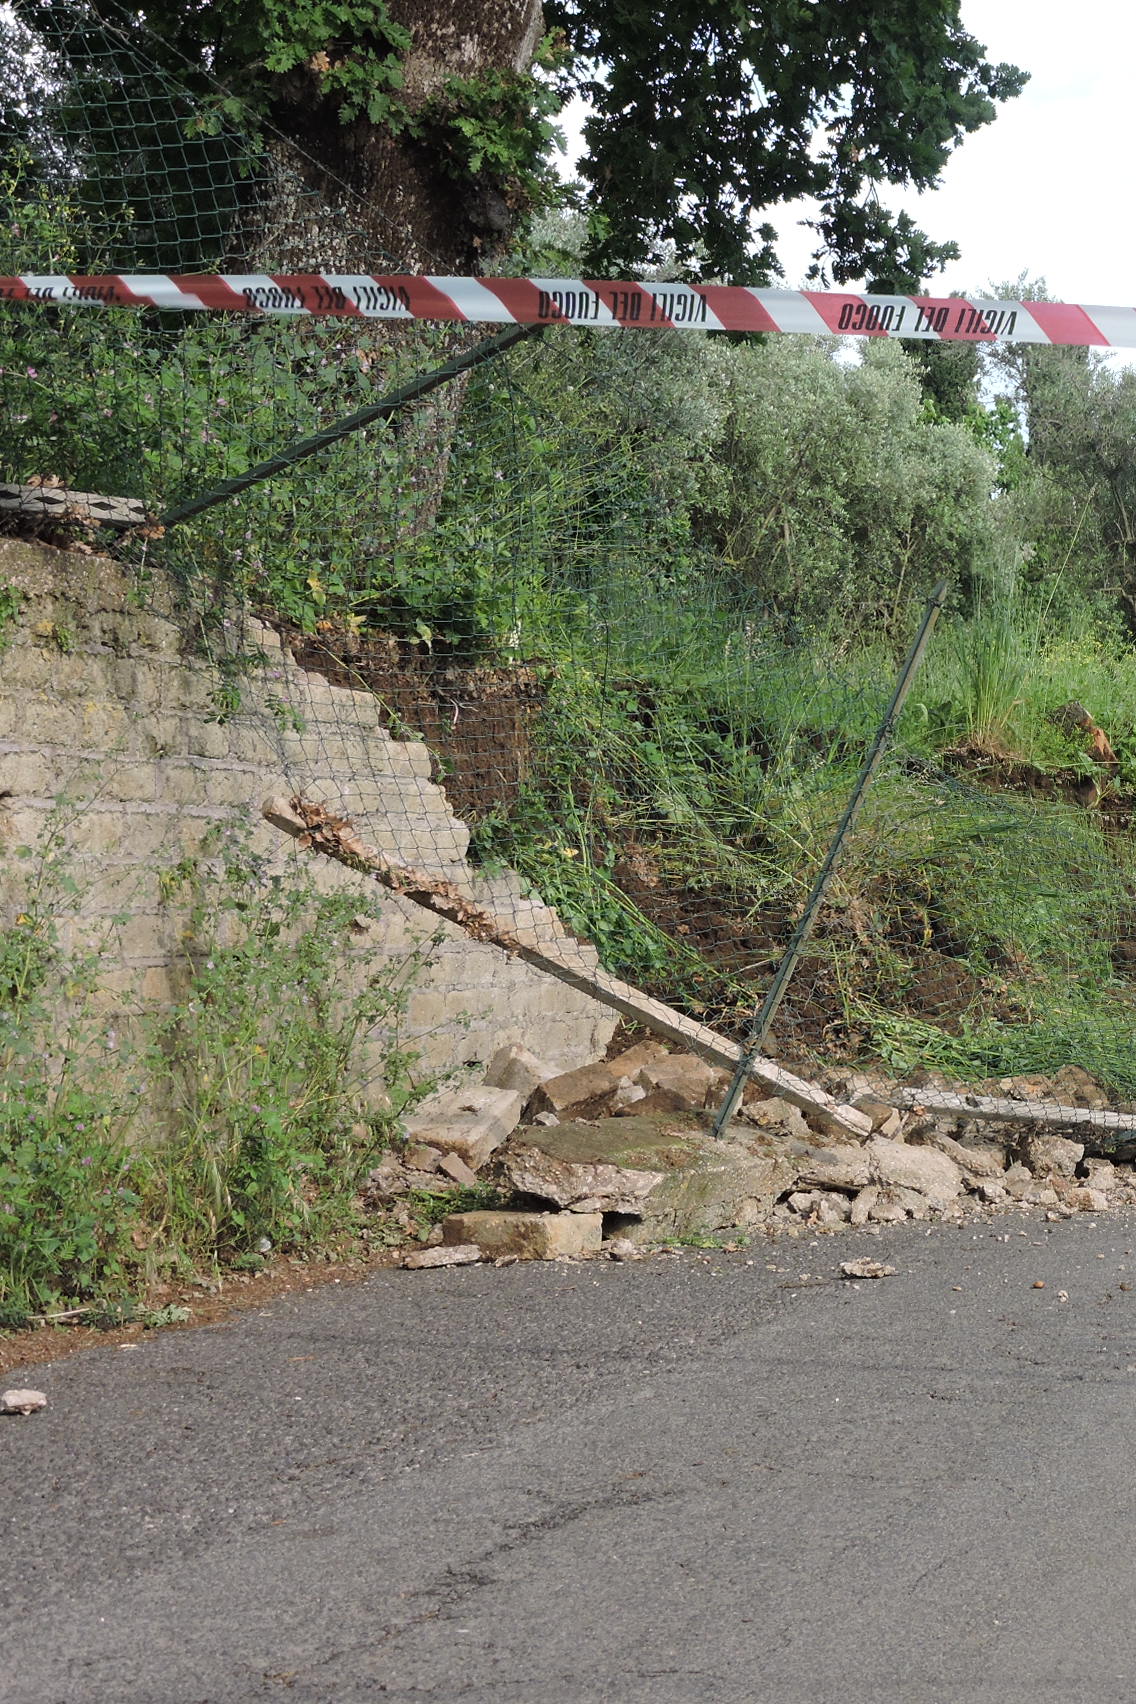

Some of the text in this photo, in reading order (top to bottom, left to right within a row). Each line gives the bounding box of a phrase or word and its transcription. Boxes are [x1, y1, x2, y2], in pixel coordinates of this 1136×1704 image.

[242, 286, 411, 311] VIGILI DEL FUOCO
[538, 291, 707, 322] VIGILI DEL FUOCO
[837, 303, 1018, 335] VIGILI DEL FUOCO
